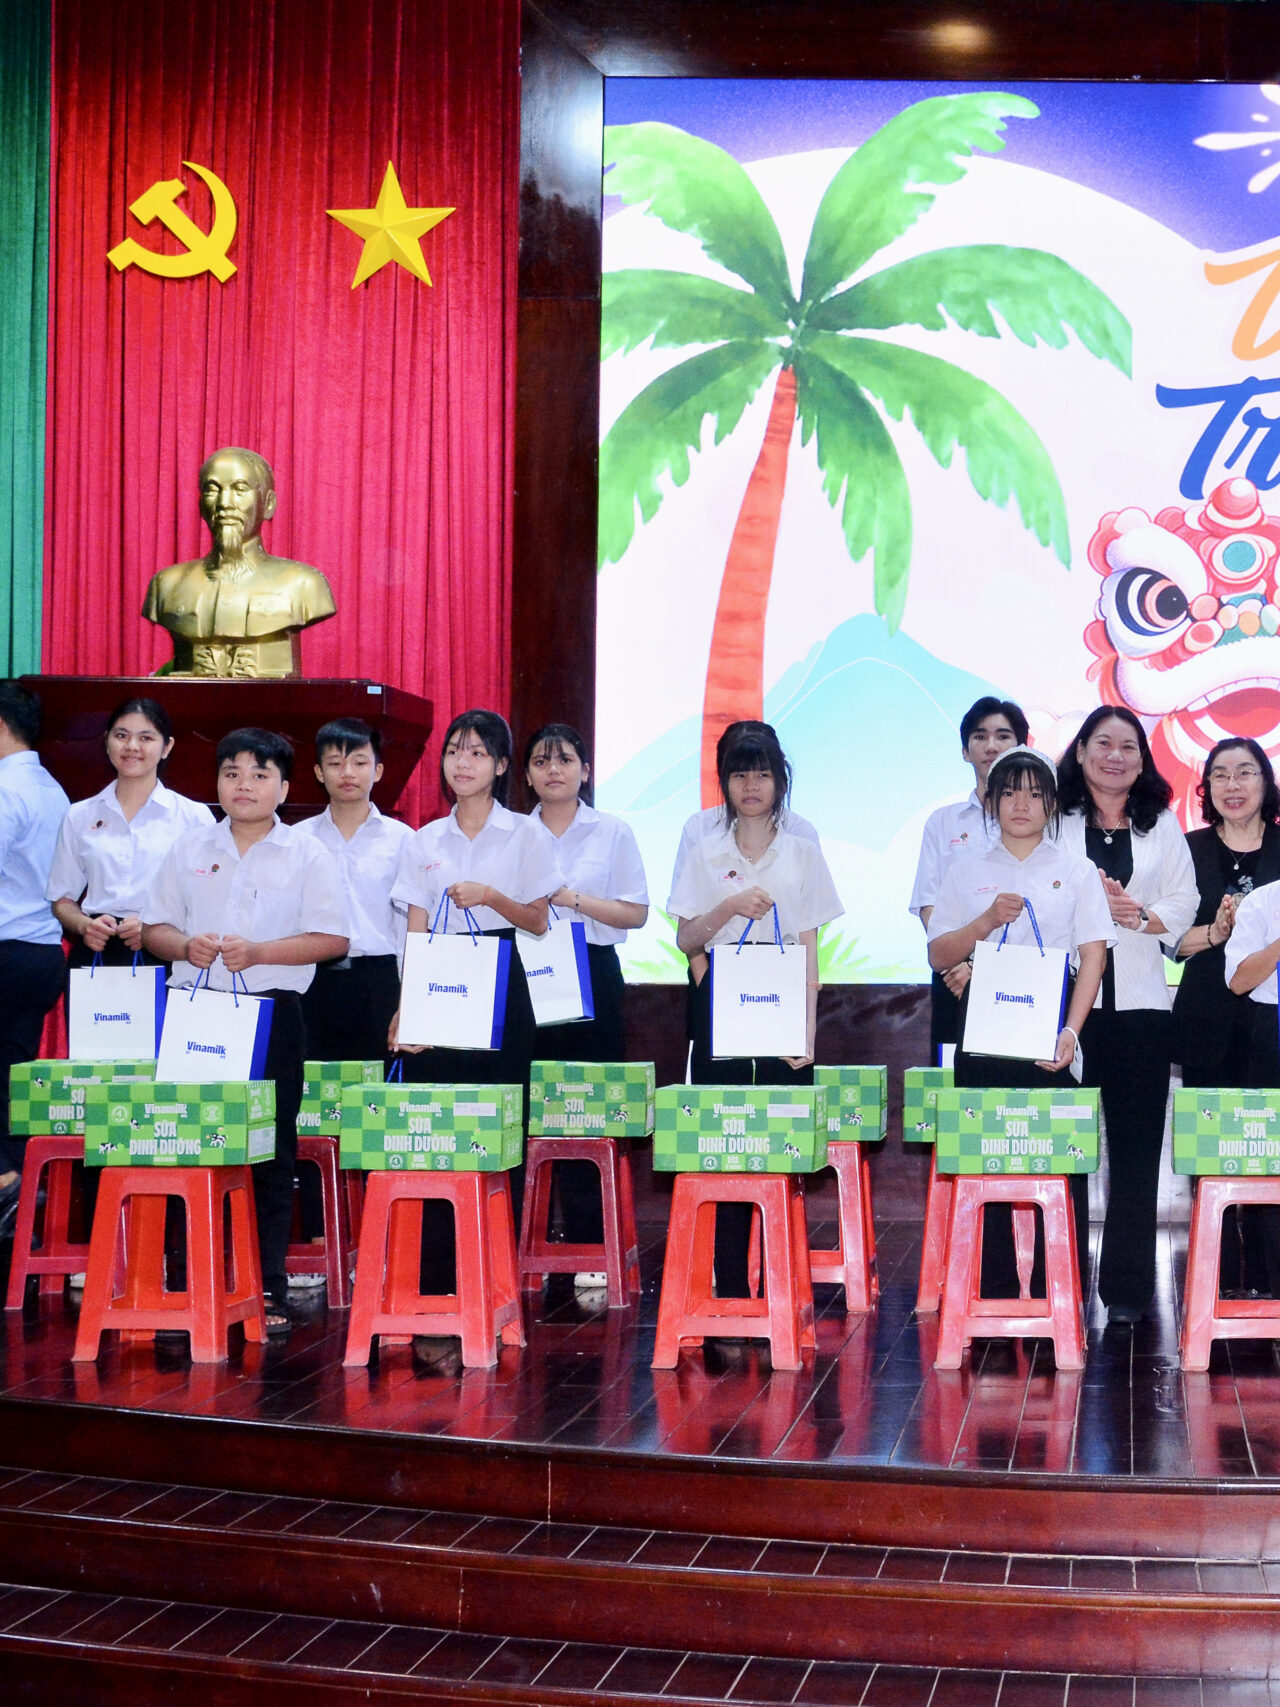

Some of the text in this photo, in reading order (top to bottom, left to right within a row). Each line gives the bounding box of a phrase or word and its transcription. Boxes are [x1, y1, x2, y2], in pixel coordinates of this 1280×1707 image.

[526, 966, 554, 978] namilk
[428, 983, 468, 994] Vinamilk
[740, 993, 780, 1003] Vinamilk
[995, 991, 1034, 1004] Vinamilk
[94, 1013, 131, 1021] Vinamilk
[187, 1041, 226, 1055] Vinamilk
[49, 1106, 74, 1119] DINH
[543, 1114, 567, 1127] DINH
[130, 1139, 157, 1155] DINH
[384, 1135, 412, 1151] DINH
[698, 1137, 727, 1153] DINH
[981, 1139, 1009, 1155] DINH
[1219, 1140, 1247, 1156] DINH
